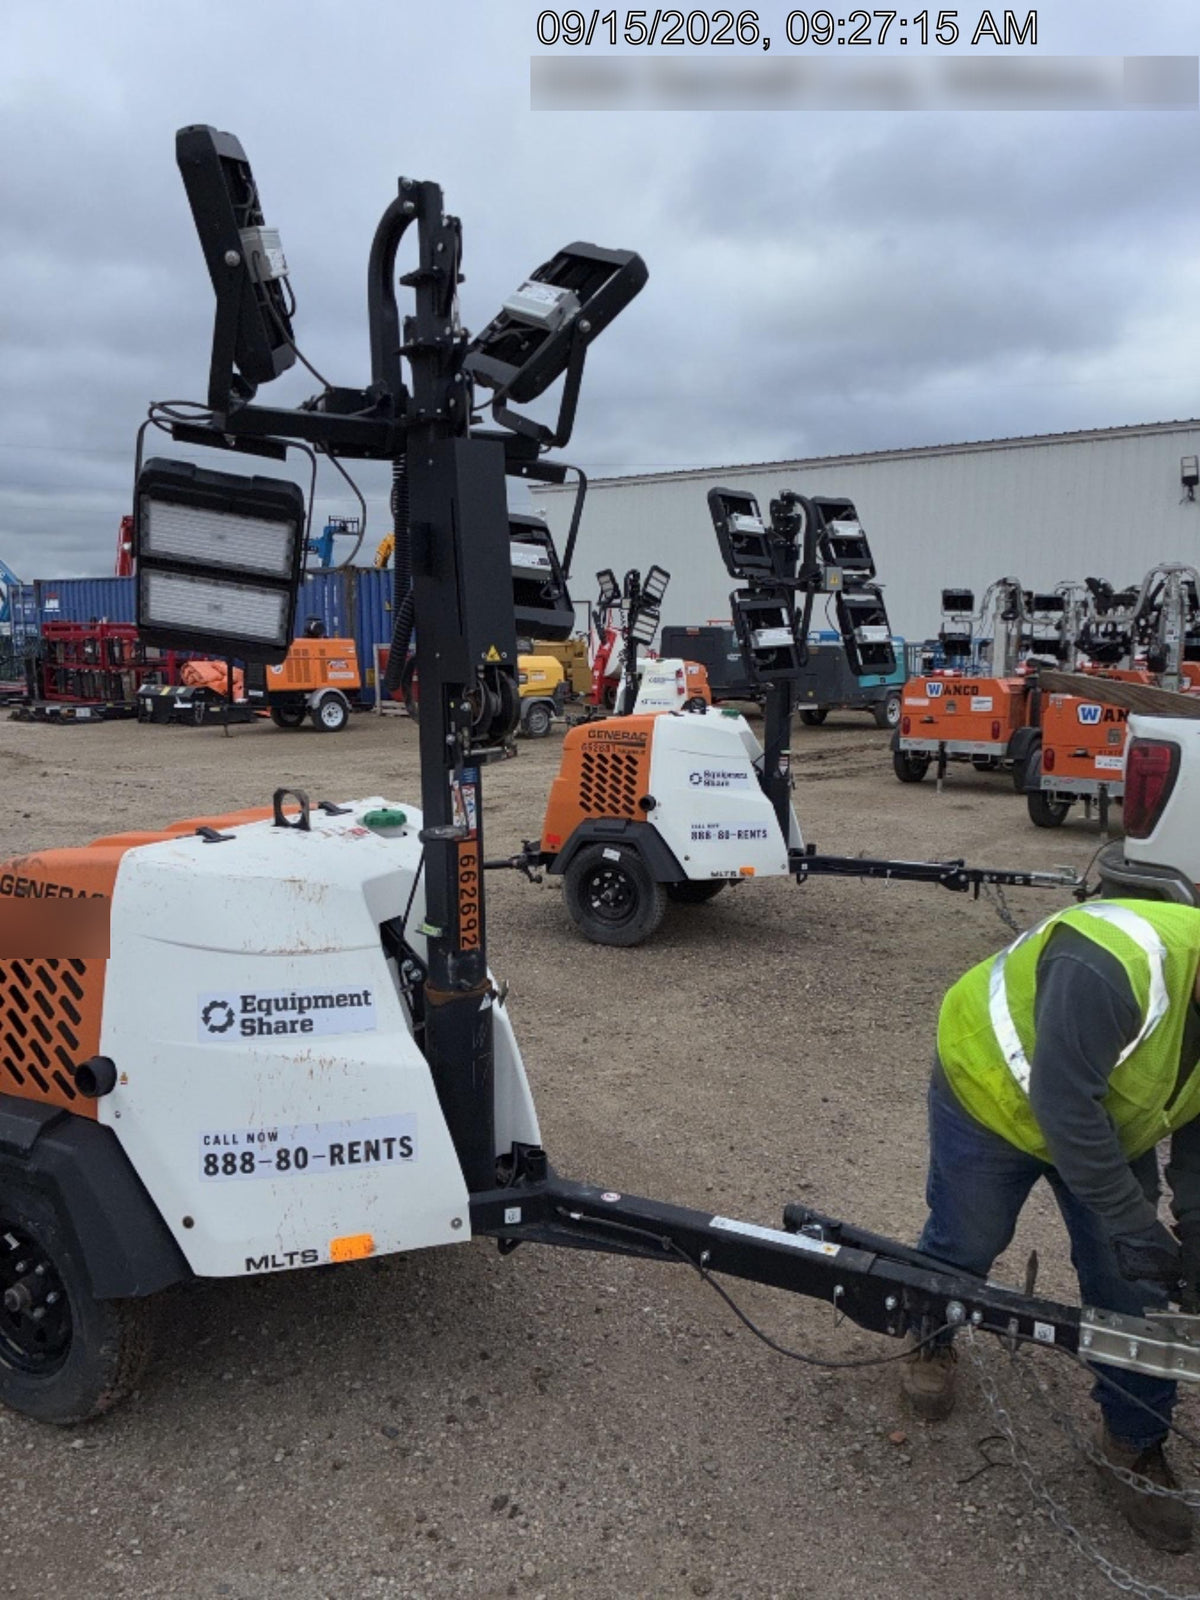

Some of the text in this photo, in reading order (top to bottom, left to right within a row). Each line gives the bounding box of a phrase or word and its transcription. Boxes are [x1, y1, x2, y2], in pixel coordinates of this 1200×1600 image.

[1078, 704, 1130, 723] WAN
[588, 730, 648, 741] GENERAC
[0, 874, 105, 899] GENER
[460, 853, 479, 949] 662692
[239, 989, 373, 1017] Equipment
[240, 1017, 314, 1037] Share
[203, 1131, 278, 1146] CALL NOW
[203, 1135, 414, 1177] 888-80-RENTS
[244, 1249, 319, 1272] MLTS
